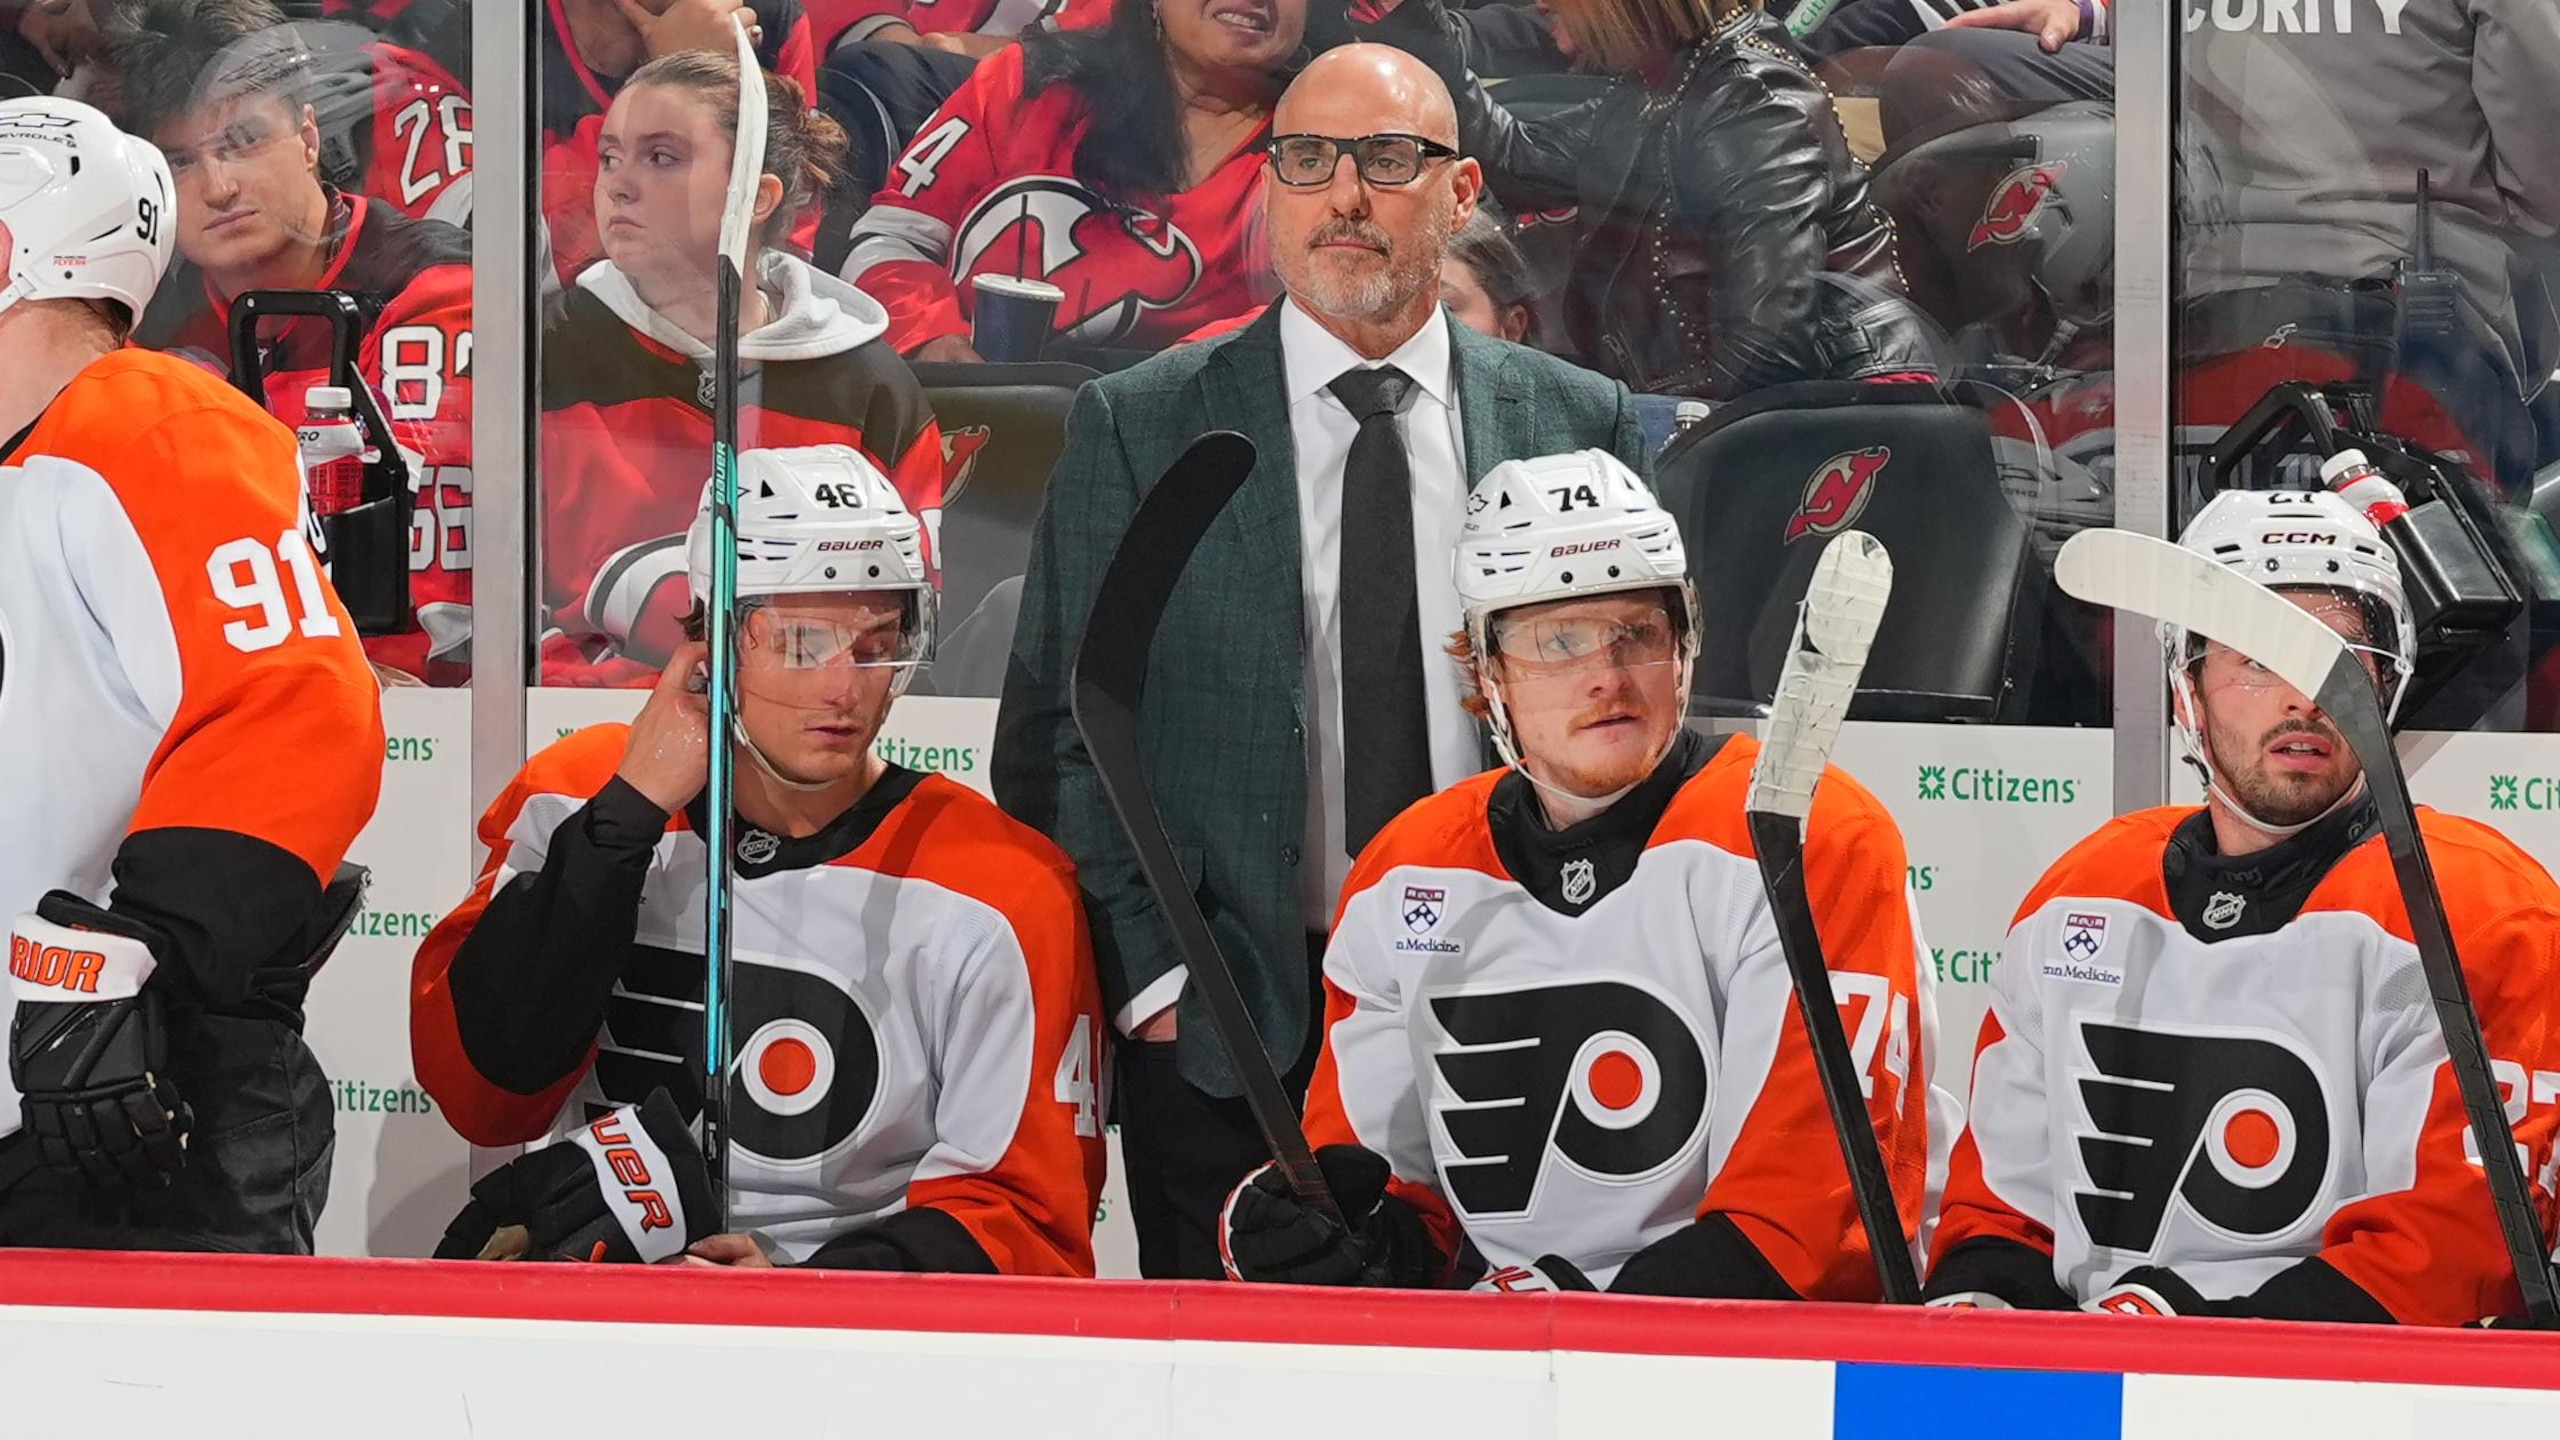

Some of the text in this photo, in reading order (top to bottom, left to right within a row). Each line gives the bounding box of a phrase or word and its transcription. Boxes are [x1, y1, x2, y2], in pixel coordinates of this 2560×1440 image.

[898, 107, 971, 198] 4
[136, 197, 158, 246] 91
[381, 325, 472, 420] 8
[815, 483, 863, 509] 46
[1548, 484, 1600, 512] 74
[816, 539, 885, 552] BAUER
[1550, 538, 1621, 558] BAUER
[2261, 532, 2338, 545] CCM
[205, 529, 342, 653] 91
[877, 737, 975, 772] itizens
[1952, 768, 2076, 804] Citizens
[1054, 1014, 1106, 1138] 4
[328, 1079, 432, 1114] itizens
